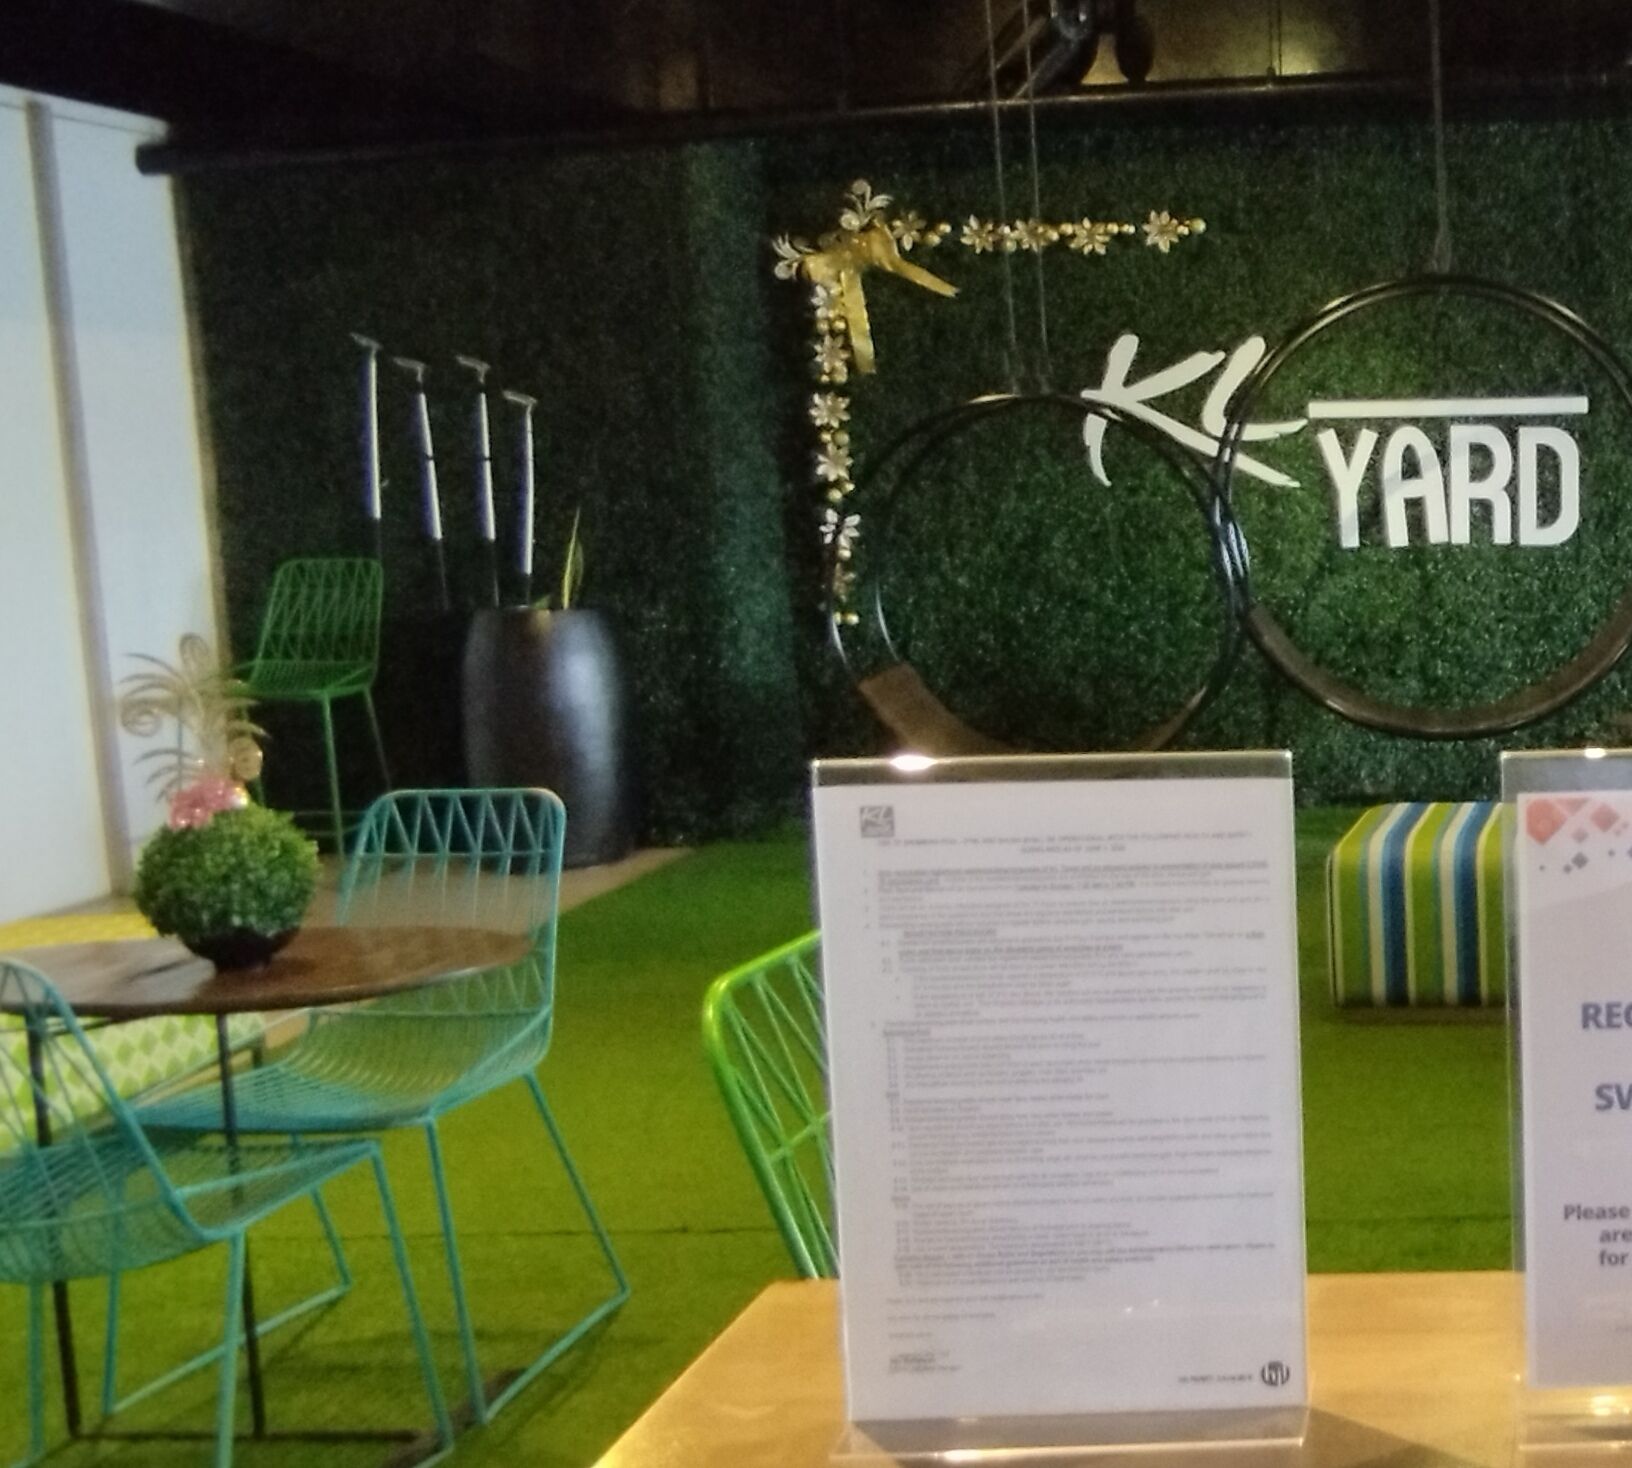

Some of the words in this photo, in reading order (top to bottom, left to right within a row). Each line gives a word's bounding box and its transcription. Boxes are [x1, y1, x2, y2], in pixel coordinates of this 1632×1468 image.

[1080, 333, 1308, 487] KL
[1316, 423, 1581, 549] YARD
[1563, 1203, 1631, 1221] Please
[1599, 1249, 1629, 1266] for
